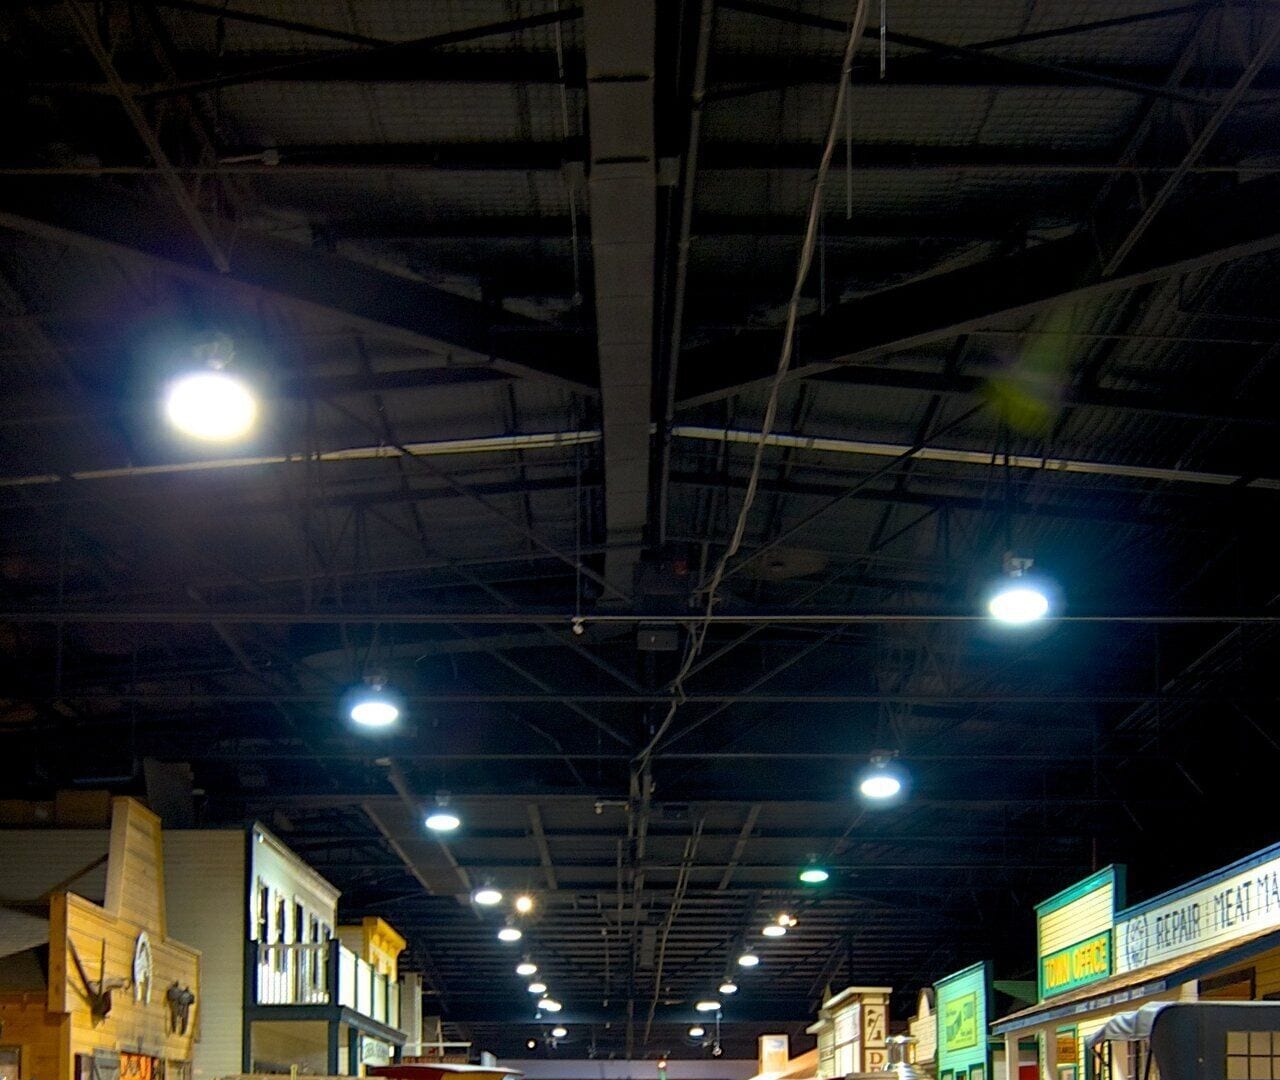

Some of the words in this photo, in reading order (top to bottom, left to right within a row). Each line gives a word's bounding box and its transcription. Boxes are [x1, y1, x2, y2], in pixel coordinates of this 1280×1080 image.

[1156, 903, 1201, 950] REPAIR
[1214, 880, 1252, 932] MEAT
[1073, 937, 1107, 980] OFFICE
